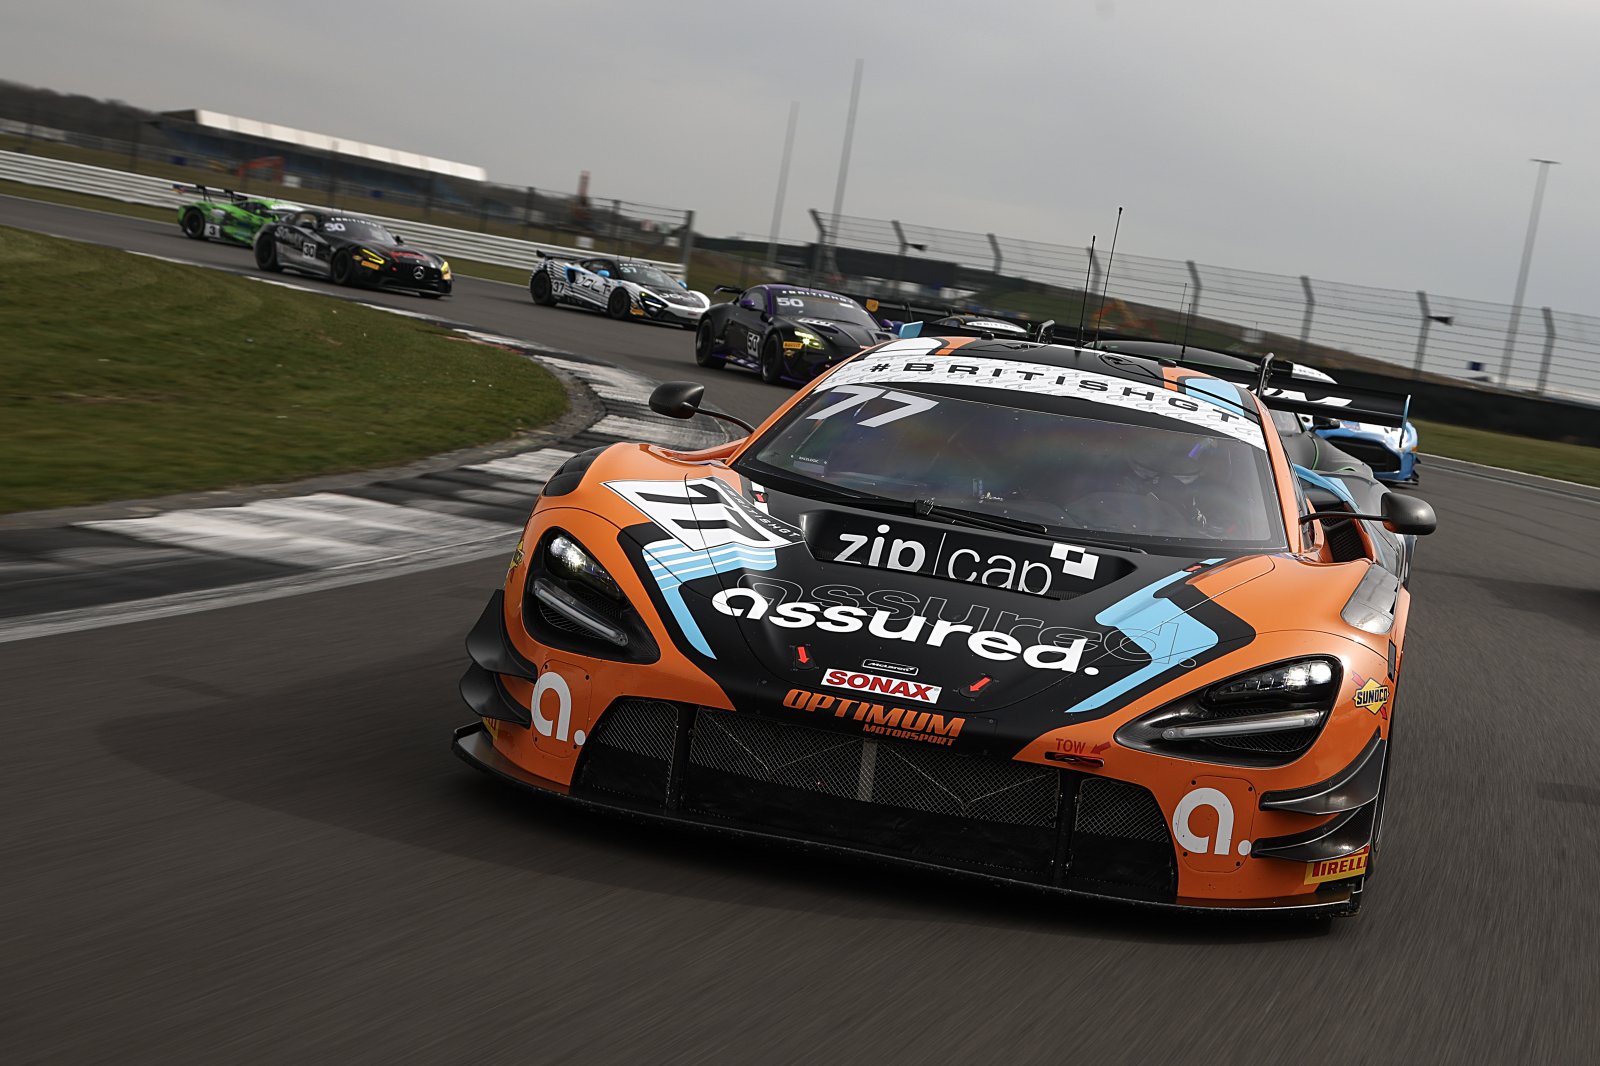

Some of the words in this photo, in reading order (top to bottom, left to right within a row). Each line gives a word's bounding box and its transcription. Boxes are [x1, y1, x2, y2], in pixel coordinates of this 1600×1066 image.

[209, 226, 216, 235] 3
[324, 222, 346, 231] 30
[304, 244, 315, 257] 30
[553, 281, 565, 293] 37
[776, 297, 804, 307] 50
[748, 333, 758, 352] 50
[869, 362, 1239, 422] #BRITISHGT
[805, 385, 940, 428] 77
[833, 524, 926, 573] zip
[947, 548, 1052, 595] cap
[711, 587, 1100, 676] assured.
[826, 670, 935, 701] SONAX
[1356, 688, 1388, 705] SUNOCO
[782, 688, 966, 738] OPTIMUM
[862, 723, 957, 747] MOTORSPORT
[1055, 738, 1087, 754] TOW
